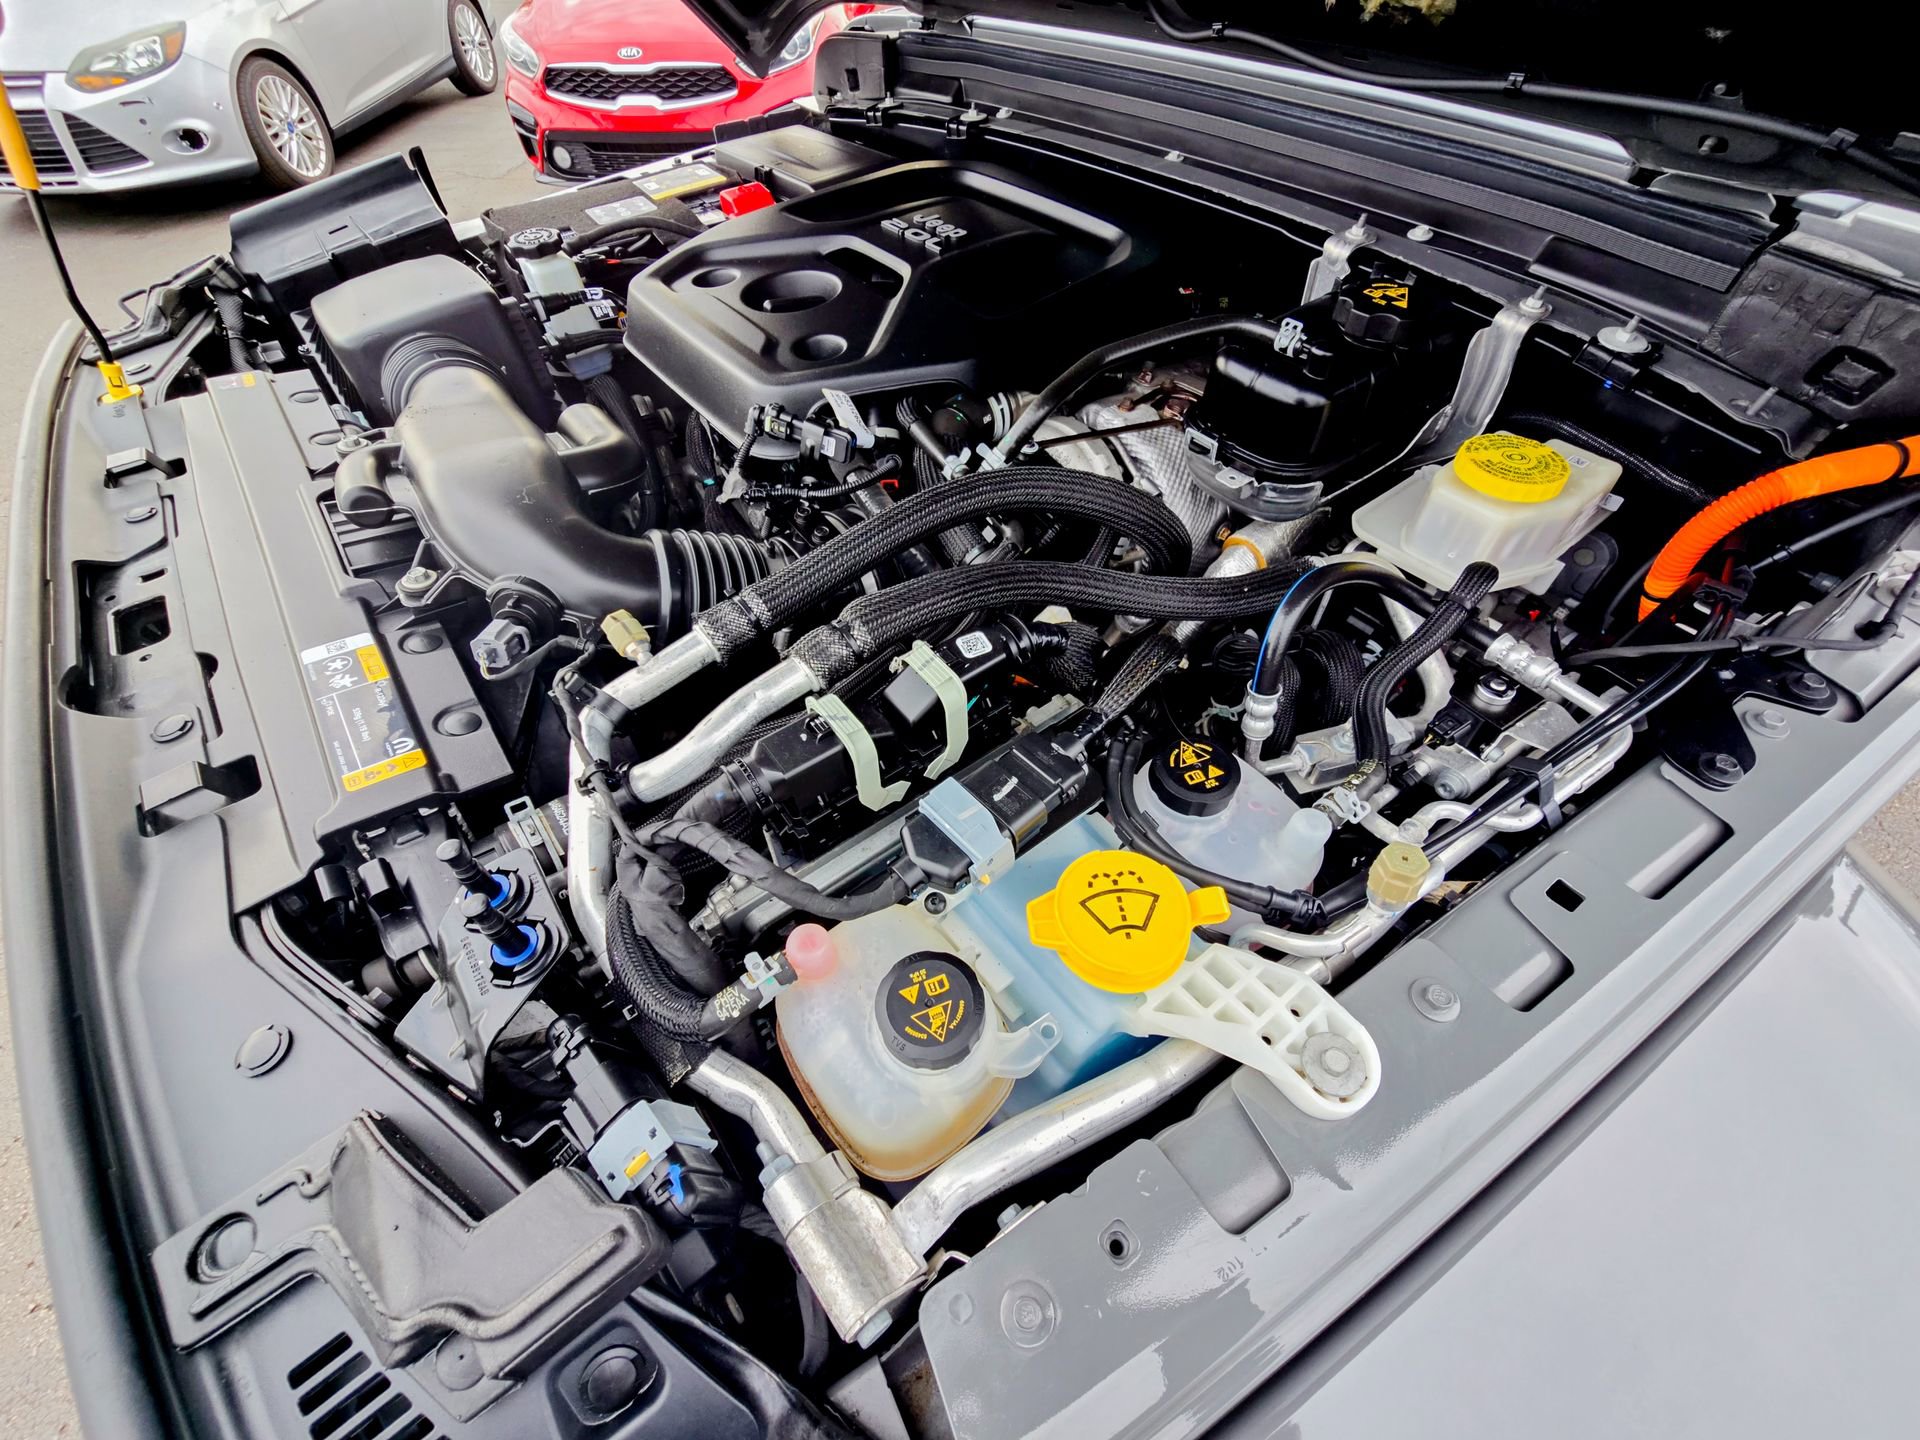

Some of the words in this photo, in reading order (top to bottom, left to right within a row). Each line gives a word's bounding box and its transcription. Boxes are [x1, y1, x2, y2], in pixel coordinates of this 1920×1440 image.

[619, 47, 639, 58] KIA
[881, 217, 942, 254] 2.0L
[913, 214, 968, 238] Jeep
[714, 986, 739, 1010] PHEV
